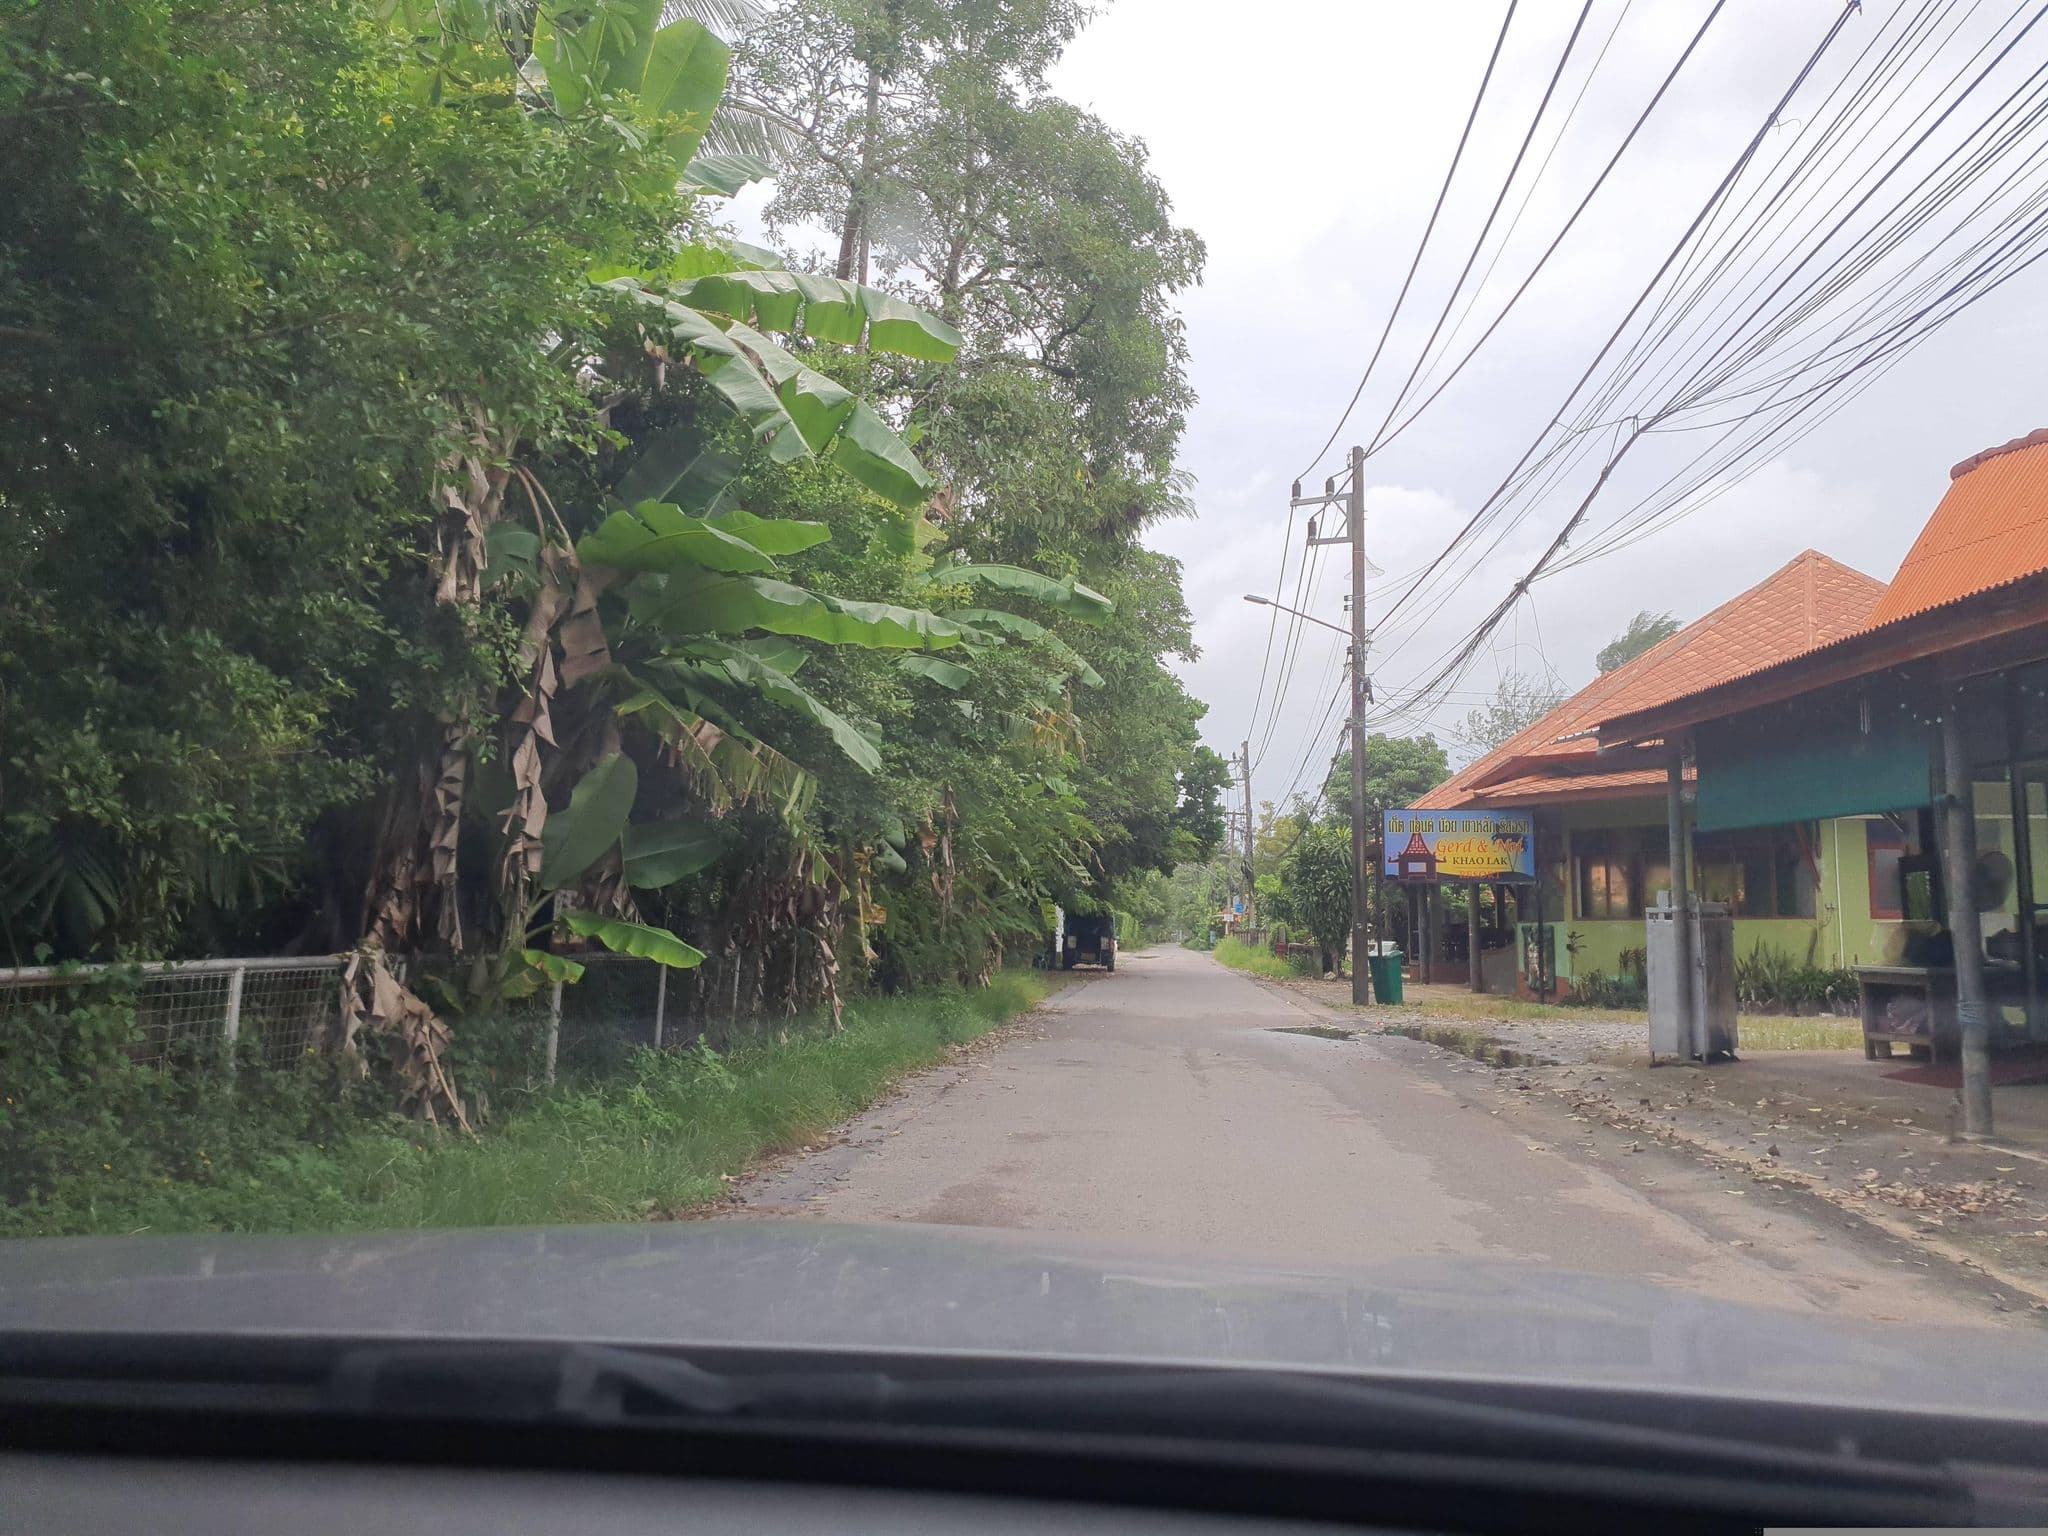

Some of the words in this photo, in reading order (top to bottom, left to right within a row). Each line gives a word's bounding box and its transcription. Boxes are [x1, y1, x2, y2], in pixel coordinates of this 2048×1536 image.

[1438, 816, 1457, 833] น้อย
[1462, 815, 1495, 833] เขาหลัก
[1436, 837, 1473, 853] Gerd
[1477, 839, 1489, 853] &
[1453, 857, 1484, 866] KHAO
[1487, 857, 1508, 866] LAK
